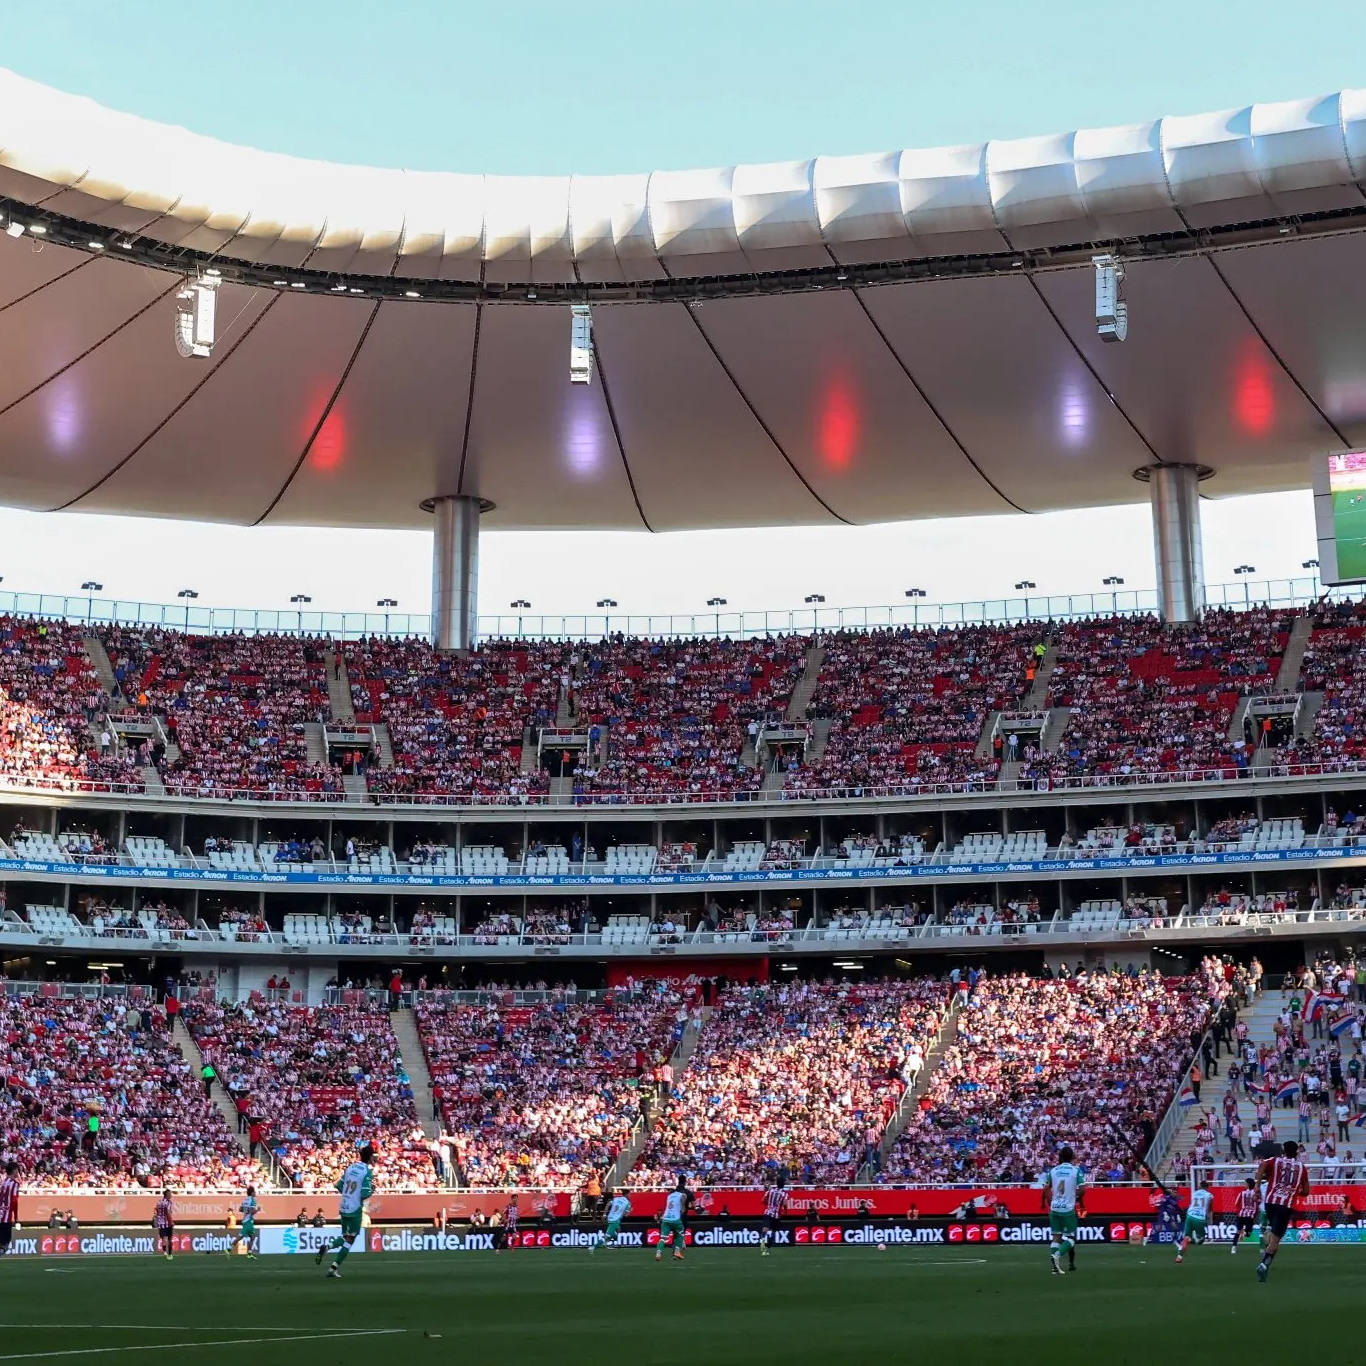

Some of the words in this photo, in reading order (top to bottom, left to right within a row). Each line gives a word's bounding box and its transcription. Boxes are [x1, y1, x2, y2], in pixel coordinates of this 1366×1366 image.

[1224, 854, 1250, 862] Estadio
[1251, 851, 1279, 860] AKRON
[1287, 850, 1313, 859] Estadio
[1314, 848, 1343, 857] AKRON
[1101, 859, 1127, 867] Estadio
[1128, 857, 1155, 866] AKRON
[1162, 856, 1188, 865] Estadio
[1189, 854, 1217, 863] AKRON
[22, 862, 47, 871] AKRON
[54, 864, 78, 873] Estadio
[79, 865, 107, 874] AKRON
[944, 865, 972, 874] AKRON
[1005, 863, 1032, 871] AKRON
[1039, 862, 1065, 870] Estadio
[1066, 860, 1093, 869] AKRON
[113, 868, 139, 876] Estadio
[140, 868, 167, 877] AKRON
[174, 870, 199, 879] Estadio
[200, 871, 227, 880] AKRON
[765, 872, 792, 880] AKRON
[825, 870, 852, 878] AKRON
[885, 868, 911, 876] AKRON
[234, 873, 258, 881] Estadio
[259, 873, 287, 882] AKRON
[345, 875, 372, 883] AKRON
[647, 875, 673, 883] AKRON
[706, 873, 732, 881] AKRON
[844, 1225, 944, 1242] caliente.mx
[80, 1234, 154, 1253] caliente.mx
[382, 1230, 494, 1250] caliente.mx
